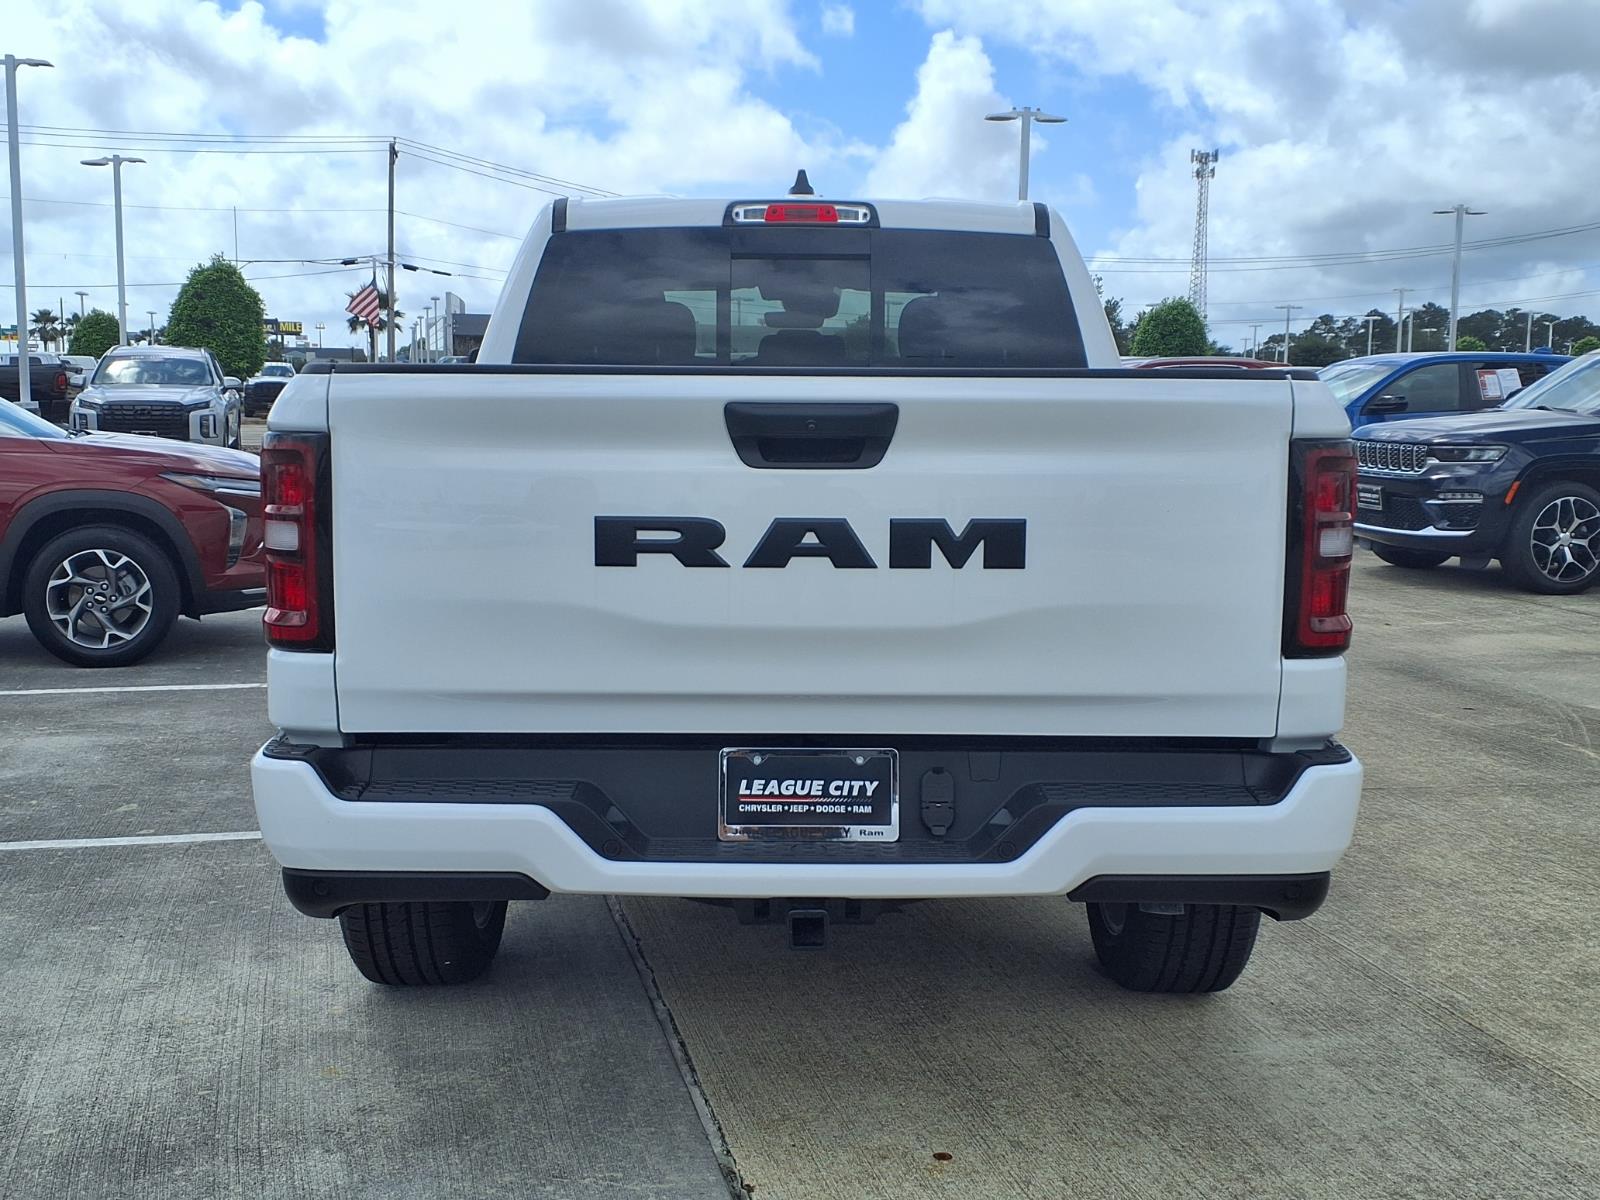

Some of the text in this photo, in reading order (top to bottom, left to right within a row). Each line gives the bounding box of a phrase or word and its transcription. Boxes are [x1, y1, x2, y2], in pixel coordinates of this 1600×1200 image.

[280, 322, 302, 332] MILE
[594, 515, 1027, 569] RAM
[739, 779, 879, 797] LEAGUE CITY
[738, 804, 872, 814] CHRYSLER JEEP DODGE RAM
[859, 828, 884, 837] Ram
